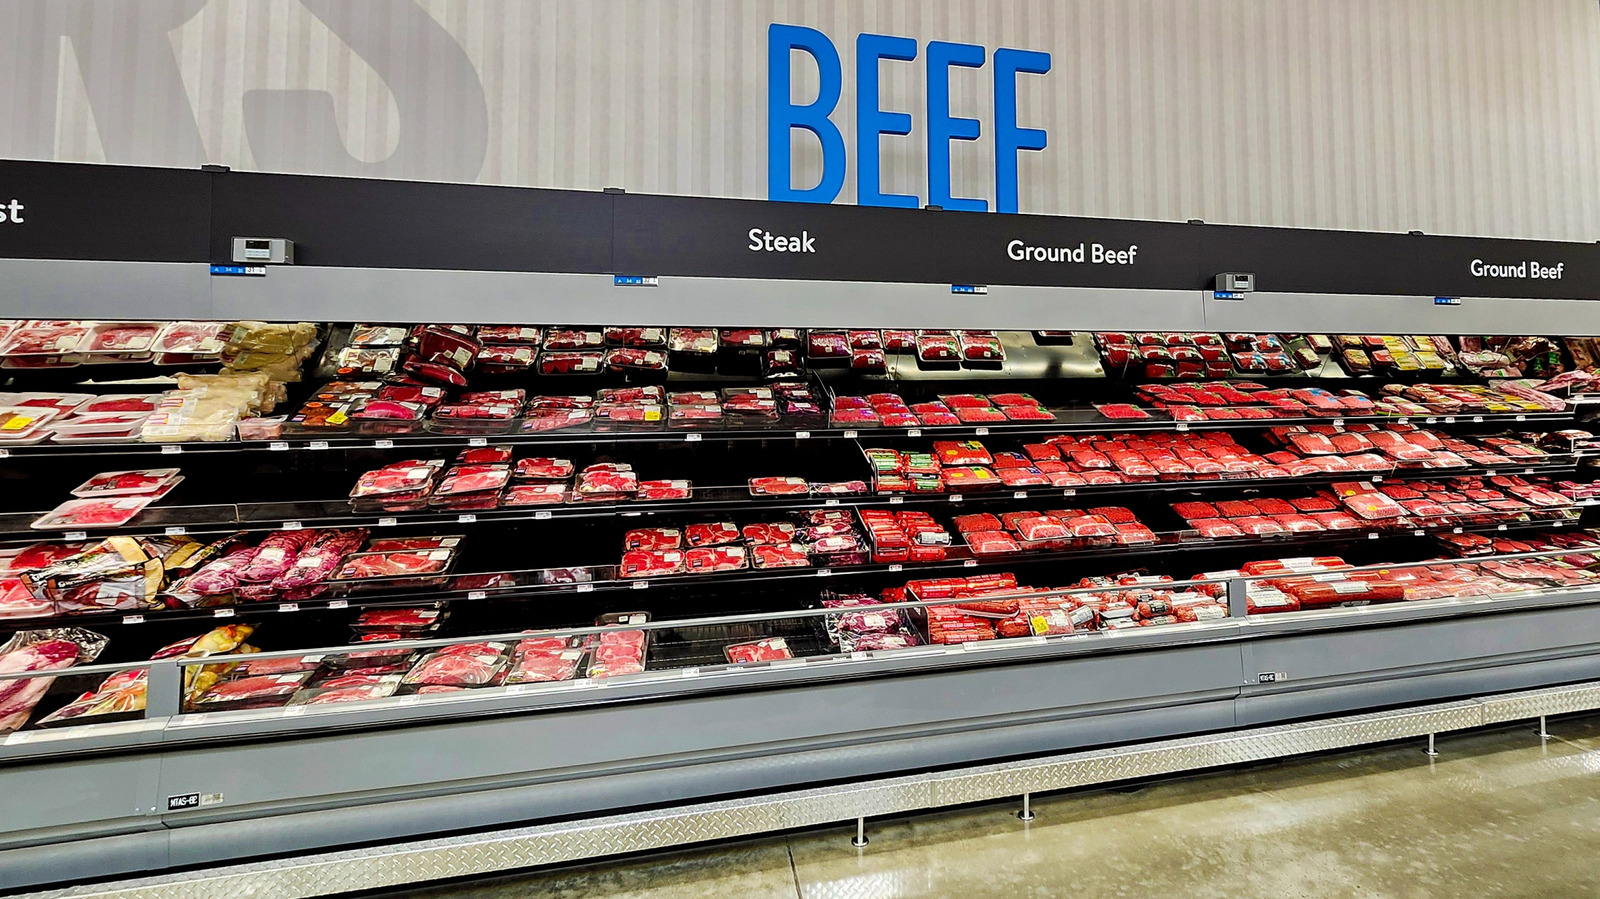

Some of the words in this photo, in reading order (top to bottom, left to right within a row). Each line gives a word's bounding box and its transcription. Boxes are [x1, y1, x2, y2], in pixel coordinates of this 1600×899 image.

[768, 23, 1051, 213] BEEF
[748, 228, 816, 253] Steak
[1007, 239, 1085, 262] Ground
[1091, 243, 1138, 265] Beef
[1470, 258, 1527, 279] Ground
[1530, 261, 1565, 280] Beef
